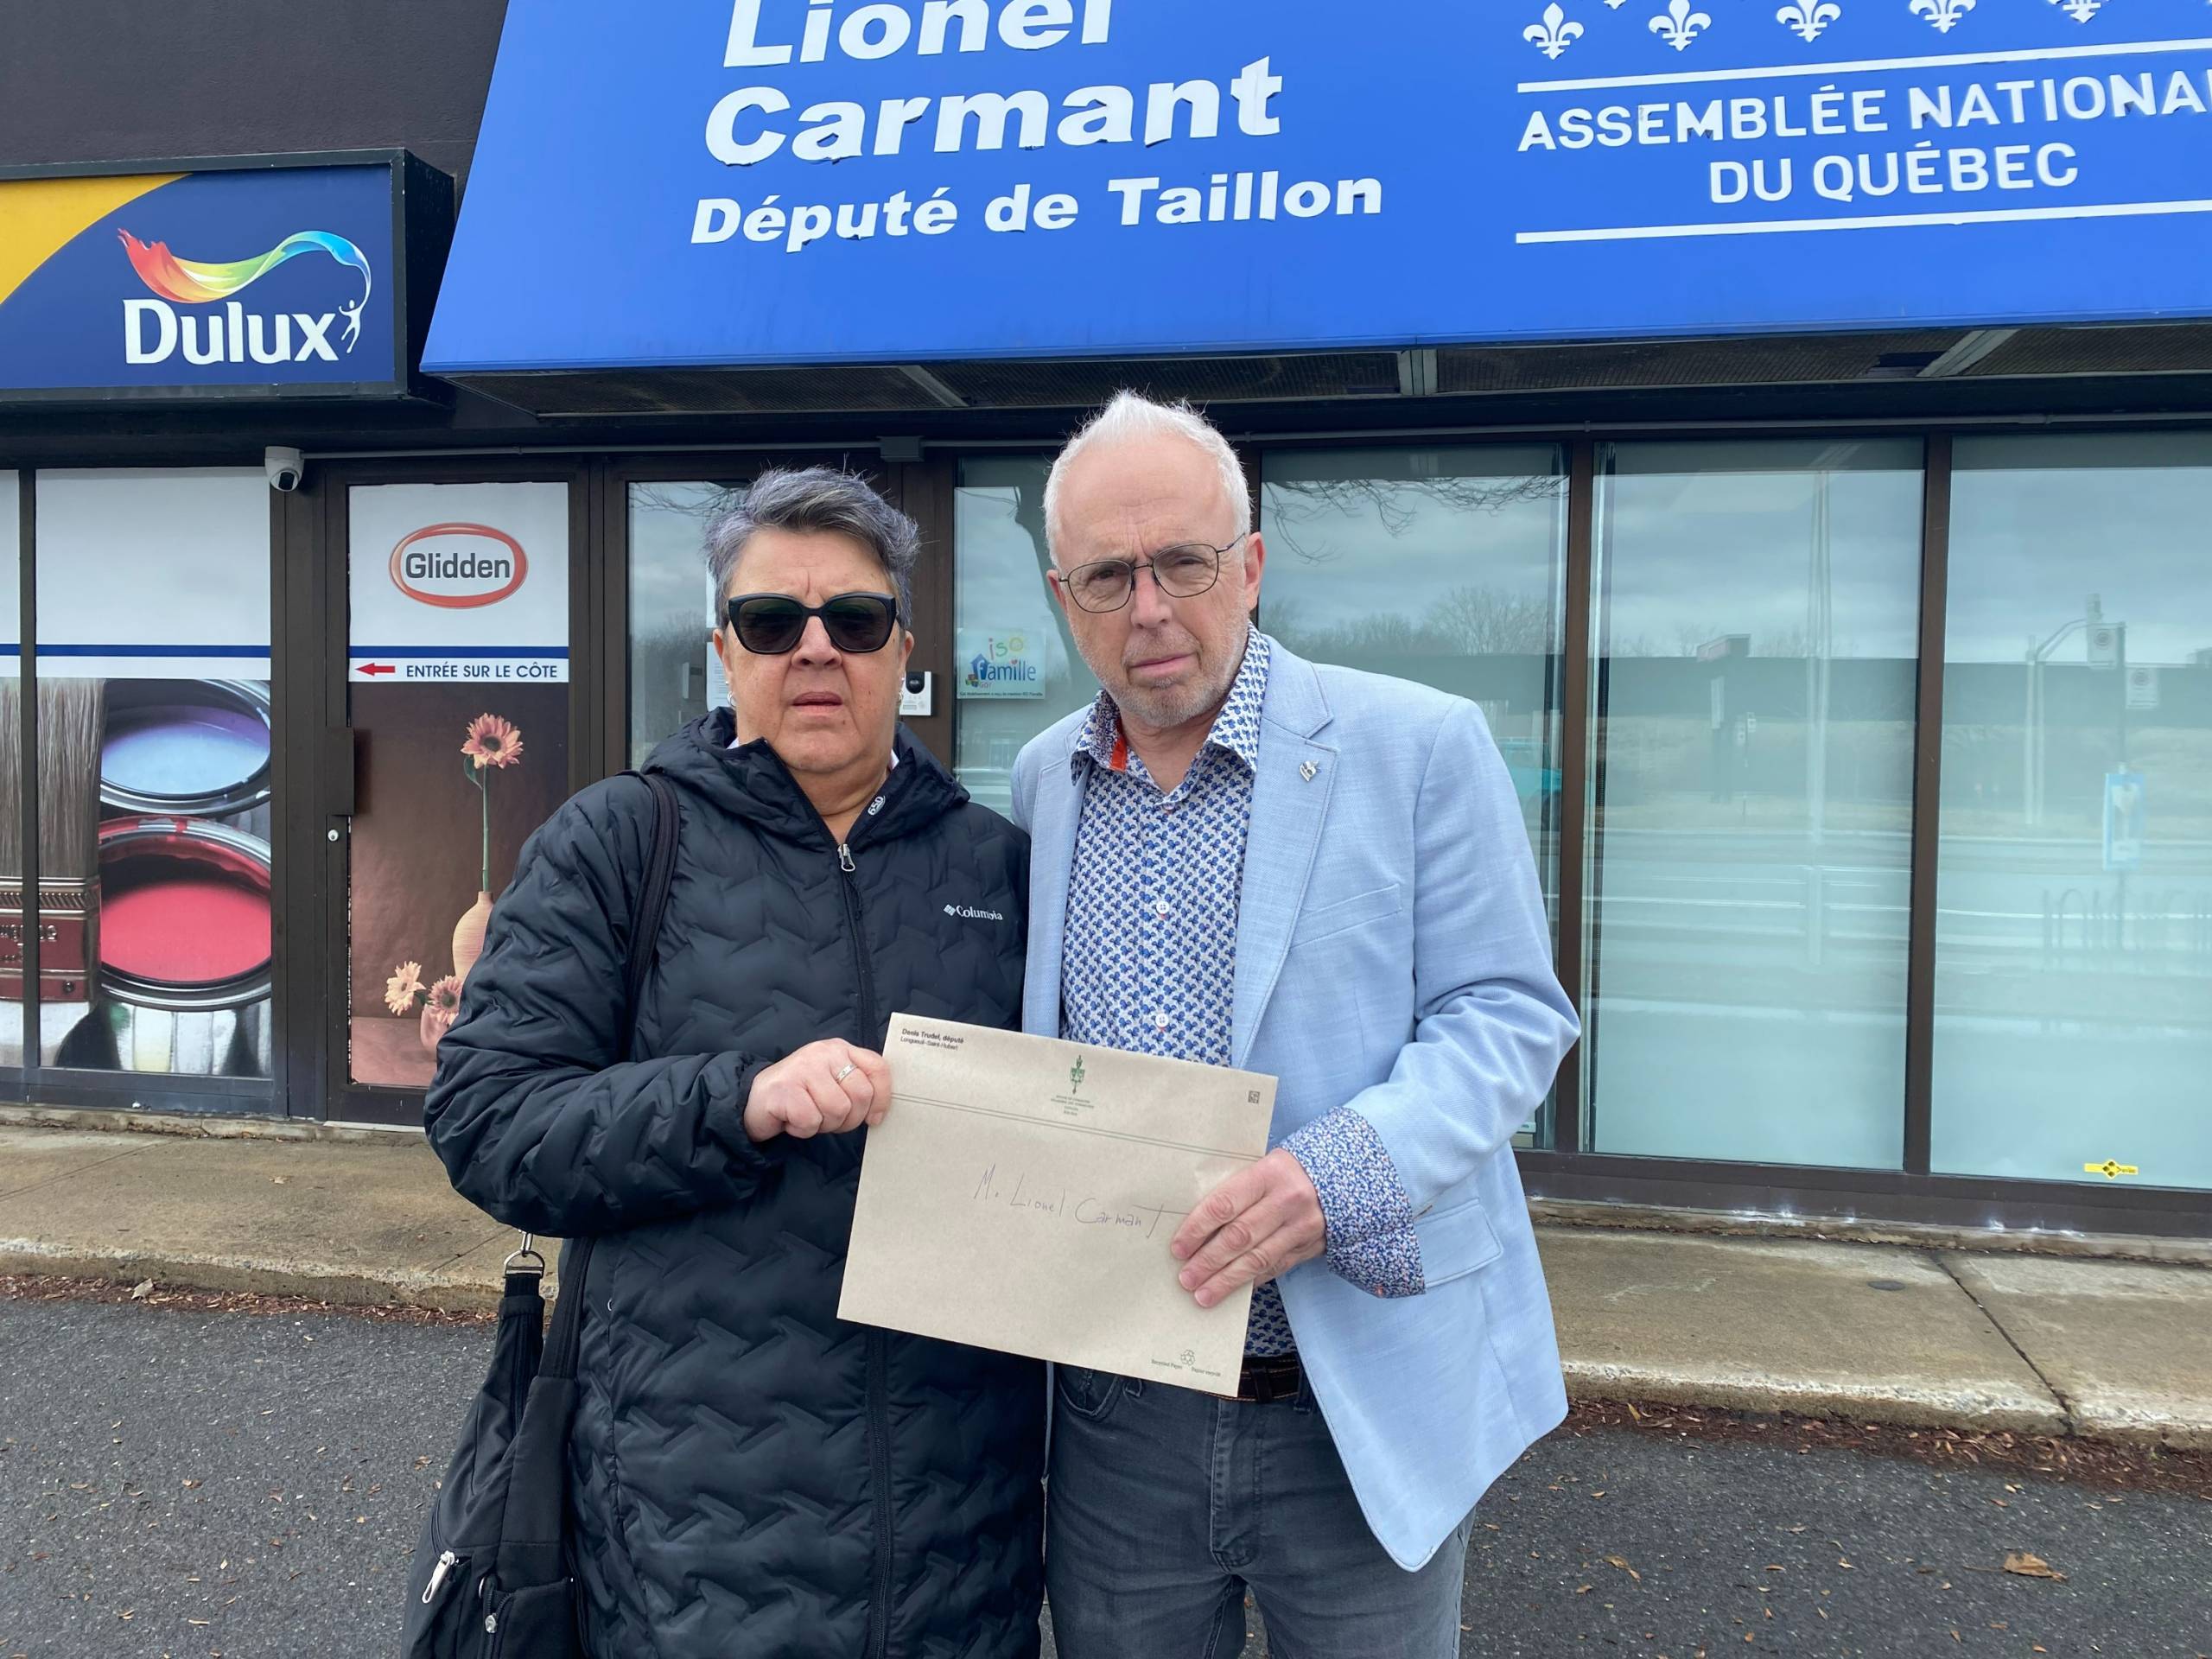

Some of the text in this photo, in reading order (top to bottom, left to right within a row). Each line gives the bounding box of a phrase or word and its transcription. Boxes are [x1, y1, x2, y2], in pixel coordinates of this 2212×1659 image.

[723, 0, 1113, 68] Lionel
[704, 58, 1284, 166] Carmant
[1518, 69, 2212, 153] ASSEMBLÉE NATIONA
[1711, 141, 2079, 204] DU QUÉBEC
[690, 171, 1383, 254] Député de Taillon
[123, 299, 340, 365] Dulux
[405, 552, 511, 580] Glidden
[406, 661, 558, 679] ENTRÉE SUR LE CÔTE
[977, 658, 1036, 681] famille
[956, 905, 1003, 920] Columbia
[901, 1028, 919, 1037] Denis
[942, 1034, 964, 1045] député
[1009, 1173, 1065, 1217] Lionel
